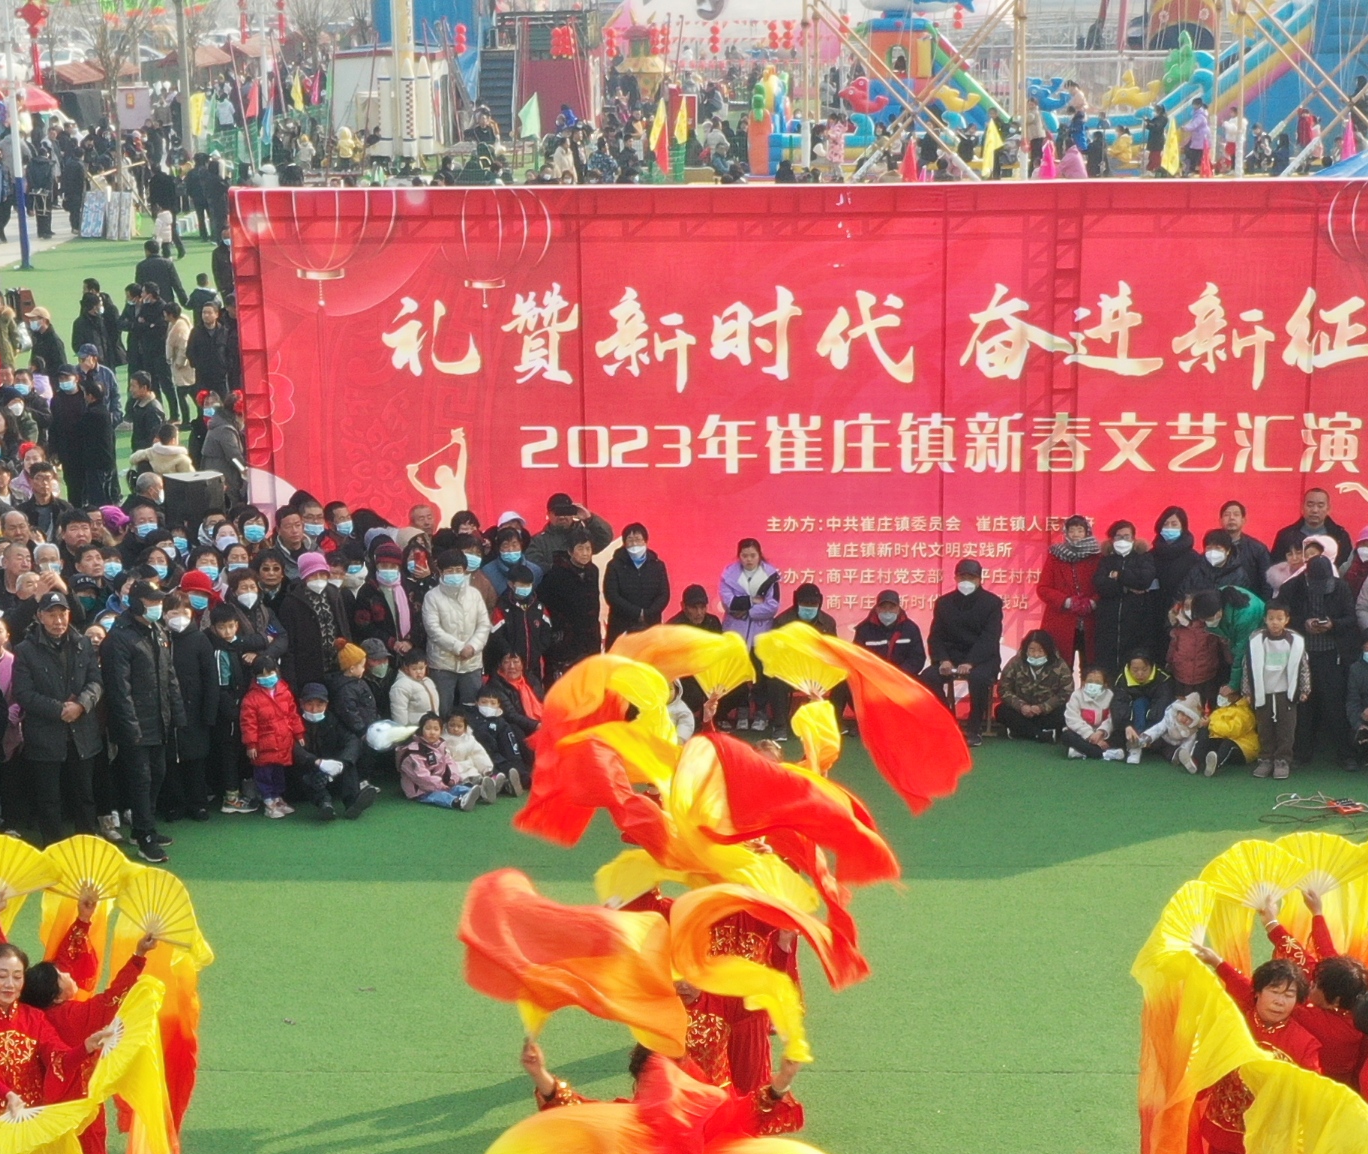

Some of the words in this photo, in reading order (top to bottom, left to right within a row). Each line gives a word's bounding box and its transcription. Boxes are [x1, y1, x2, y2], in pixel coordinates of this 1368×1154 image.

[519, 411, 1363, 474] 2023年崔庄镇新春文艺汇演
[975, 515, 1095, 532] 崔庄镇人民
[826, 542, 1013, 558] 崔庄镇新时代文明实践所
[780, 568, 943, 584] 办方：商平庄村党支部
